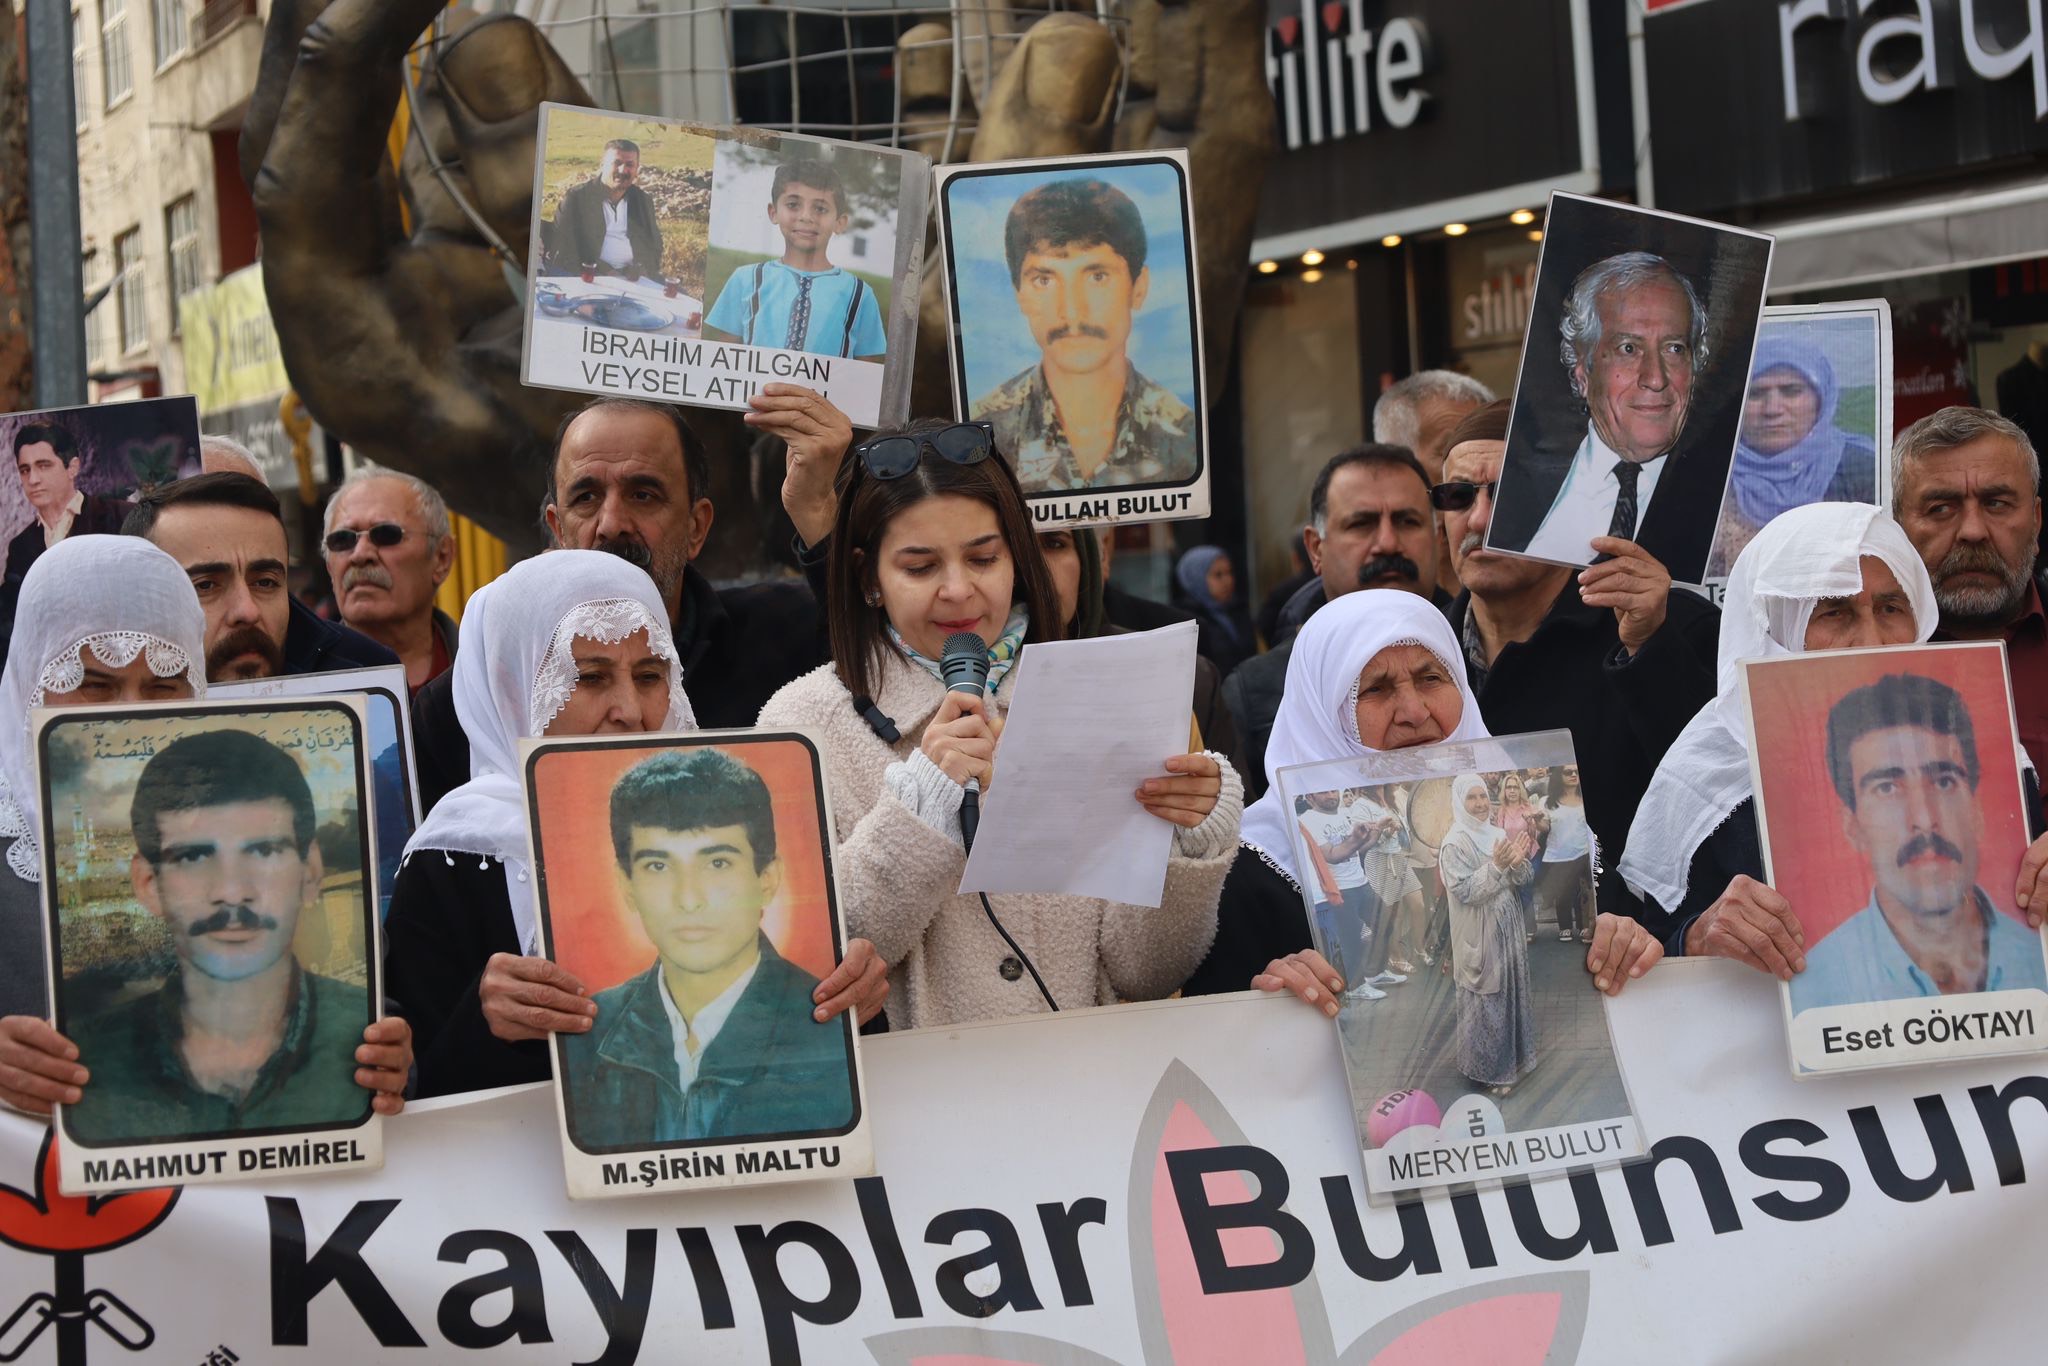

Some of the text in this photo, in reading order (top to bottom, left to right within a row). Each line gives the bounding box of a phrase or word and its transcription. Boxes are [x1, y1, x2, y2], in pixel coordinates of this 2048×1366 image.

[582, 326, 830, 382] İBRAHİM ATILGAN
[581, 361, 697, 397] VEYSEL
[1029, 493, 1192, 522] ULLAH BULUT
[1822, 1009, 2035, 1053] Eset GÖKTAYI
[83, 1139, 365, 1183] MAHMUT DEMİREL
[602, 1146, 841, 1187] M.ŞİRİN MALTU
[1388, 1125, 1623, 1181] MERYEM BULUT
[264, 1177, 1107, 1366] Kayıplar
